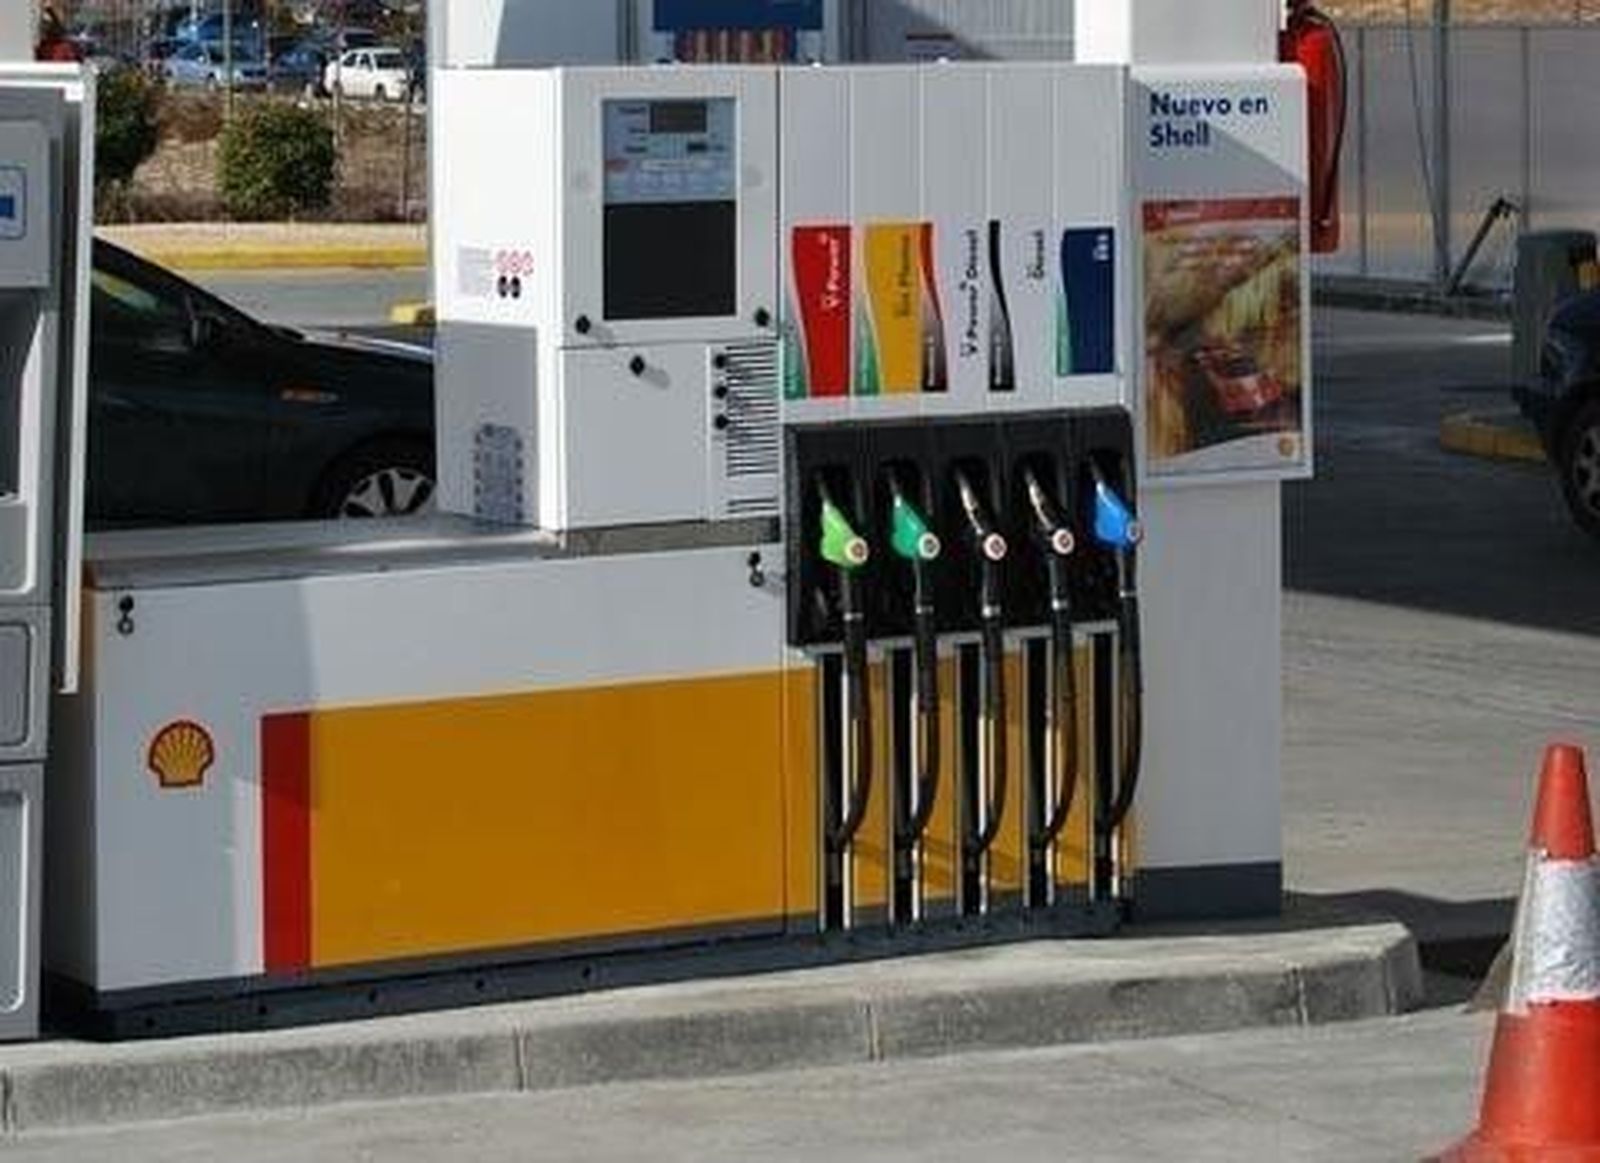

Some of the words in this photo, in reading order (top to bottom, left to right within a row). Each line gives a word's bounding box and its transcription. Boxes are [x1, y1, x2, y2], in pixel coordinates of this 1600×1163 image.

[1150, 92, 1231, 116] Nuevo
[1239, 97, 1268, 114] en
[1150, 121, 1209, 147] Shell
